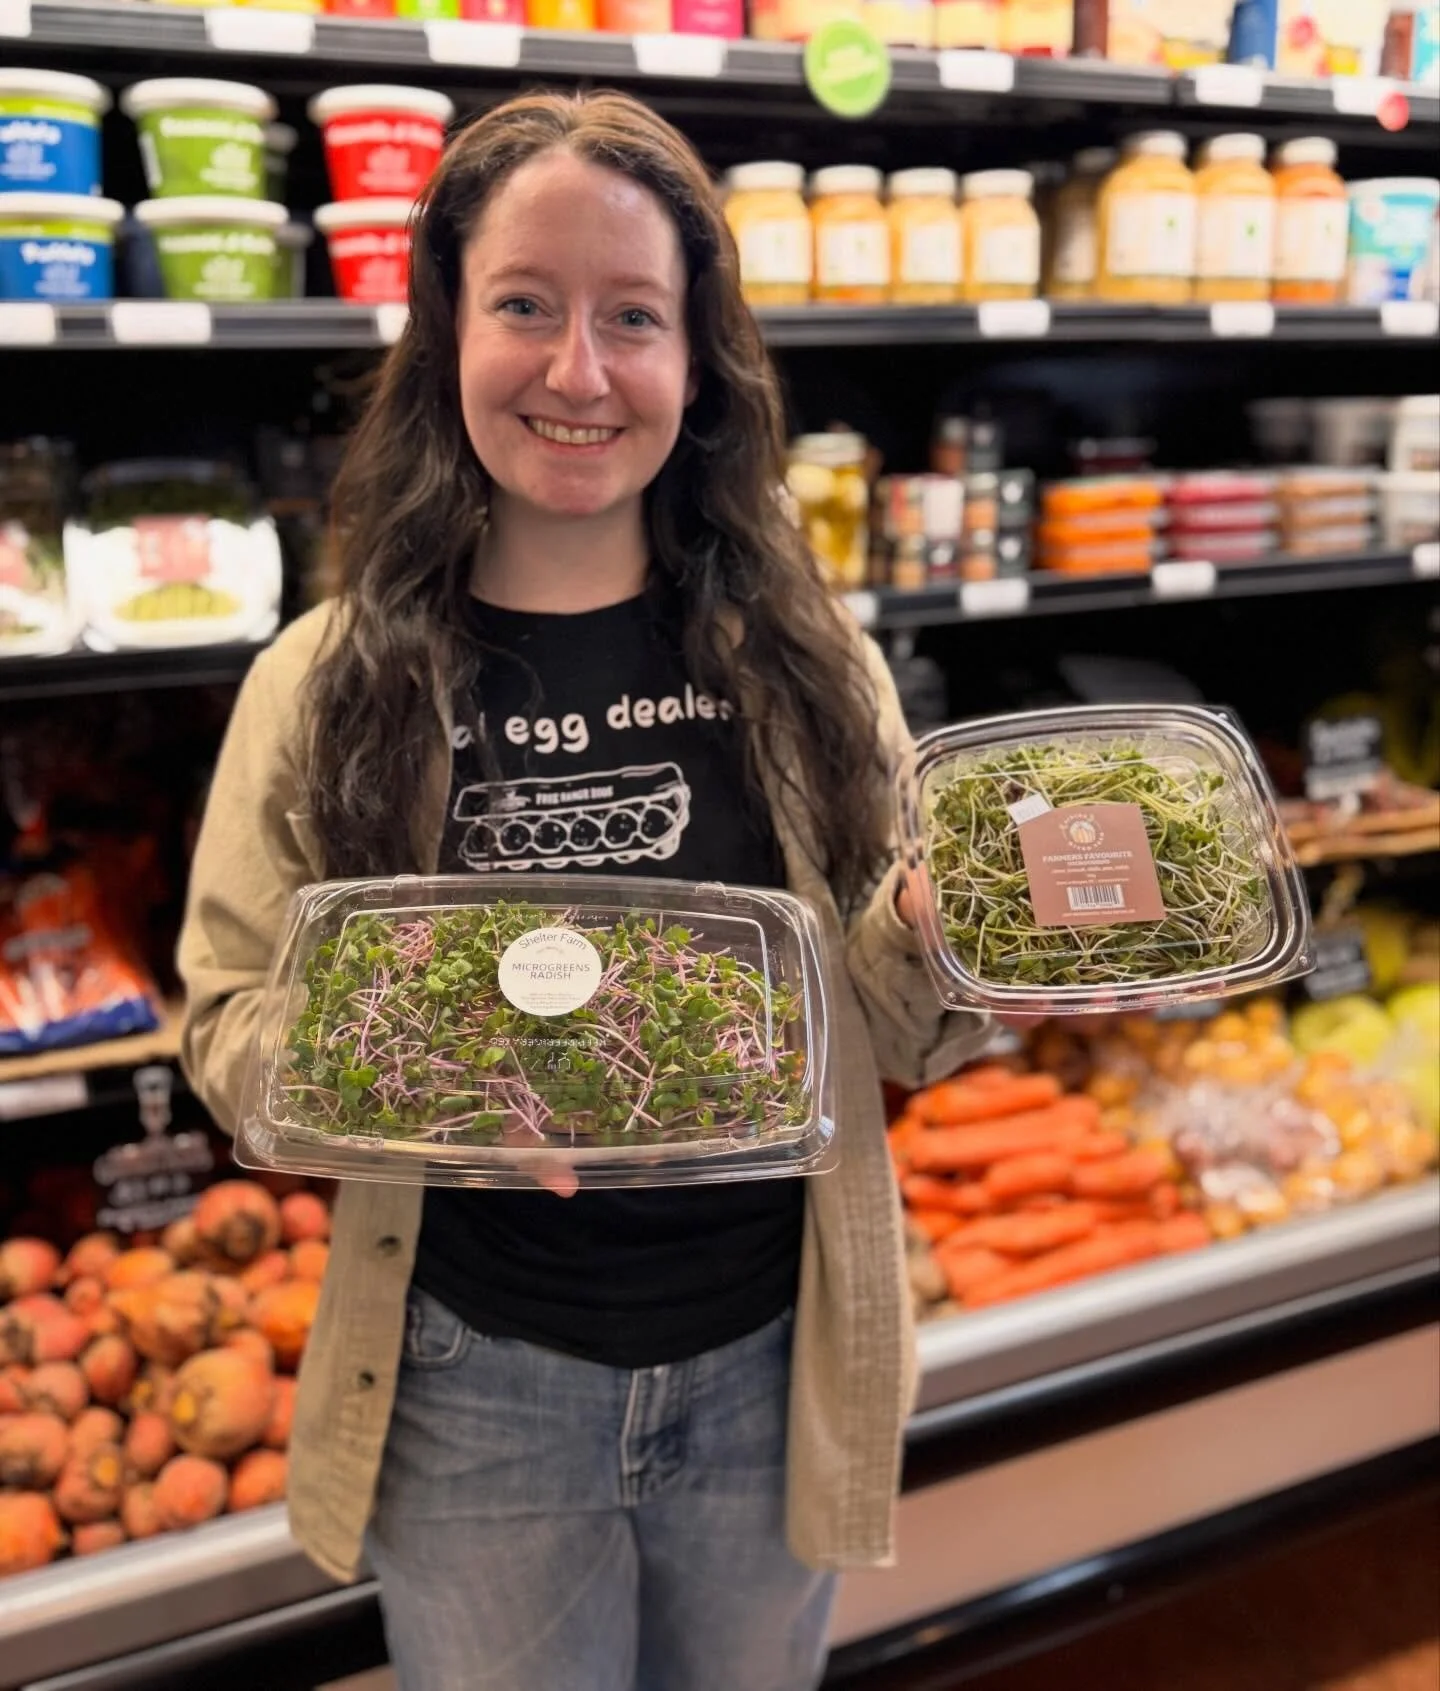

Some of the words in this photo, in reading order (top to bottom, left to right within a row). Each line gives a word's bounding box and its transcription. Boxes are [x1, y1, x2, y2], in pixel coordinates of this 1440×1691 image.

[505, 713, 590, 754] egg
[1042, 853, 1084, 863] FARMERS
[1084, 850, 1133, 860] FAVOURITE
[518, 932, 557, 949] Shelter
[560, 932, 587, 950] Farm
[511, 962, 591, 972] MICROGREENS
[530, 971, 571, 980] RADISH
